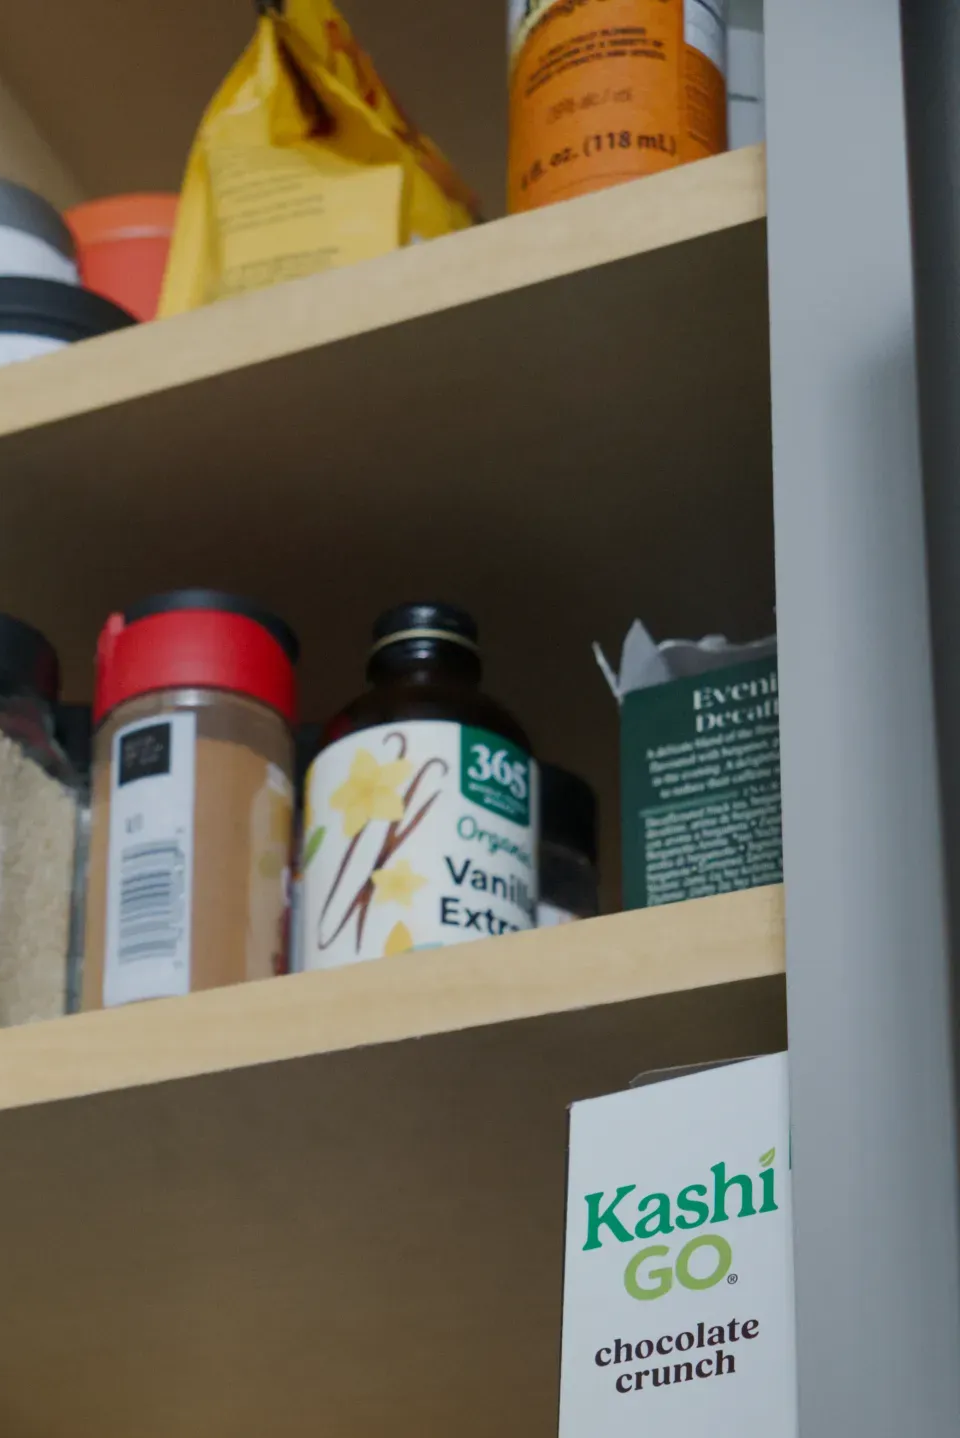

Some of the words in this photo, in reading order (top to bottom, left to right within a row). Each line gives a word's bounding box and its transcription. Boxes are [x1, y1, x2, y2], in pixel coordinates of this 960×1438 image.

[582, 130, 632, 158] (118
[637, 133, 677, 158] mL)
[693, 671, 778, 711] Eveni
[467, 742, 529, 800] 365
[444, 855, 531, 906] Vanill
[582, 1147, 779, 1251] Kashi
[594, 1317, 760, 1367] chocolate
[615, 1350, 736, 1394] crunch
